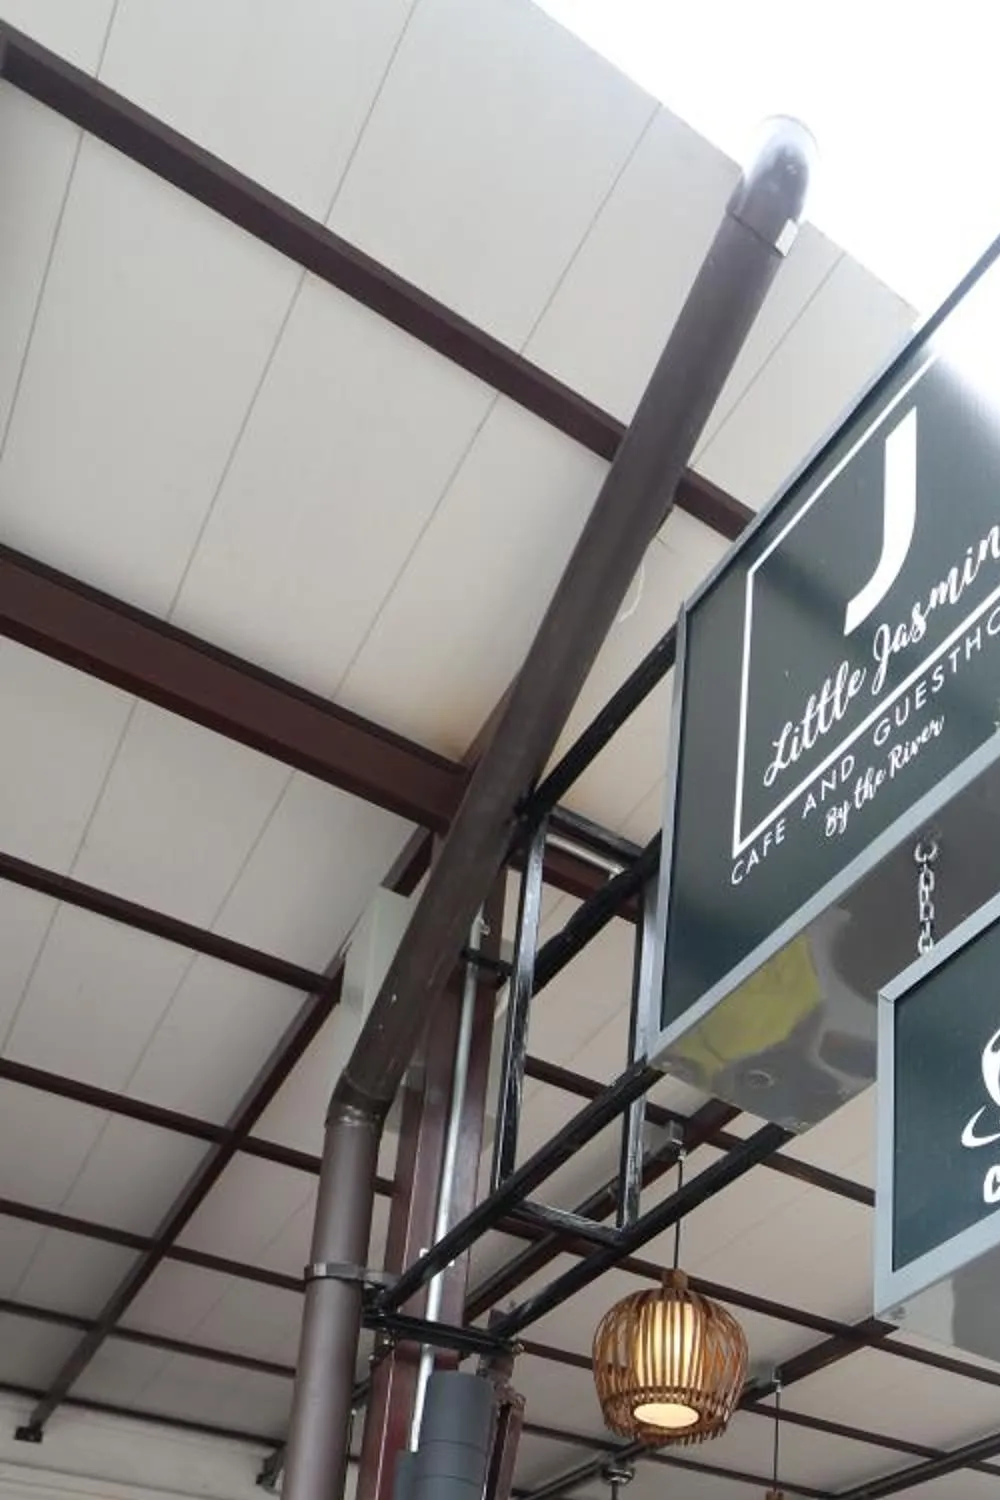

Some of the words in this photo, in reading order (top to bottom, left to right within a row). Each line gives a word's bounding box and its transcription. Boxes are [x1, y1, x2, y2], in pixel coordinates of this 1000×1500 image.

[763, 660, 867, 787] Little
[825, 800, 850, 837] By
[854, 767, 886, 809] the
[888, 715, 945, 778] River
[731, 818, 786, 885] CAFE
[802, 755, 855, 819] AND
